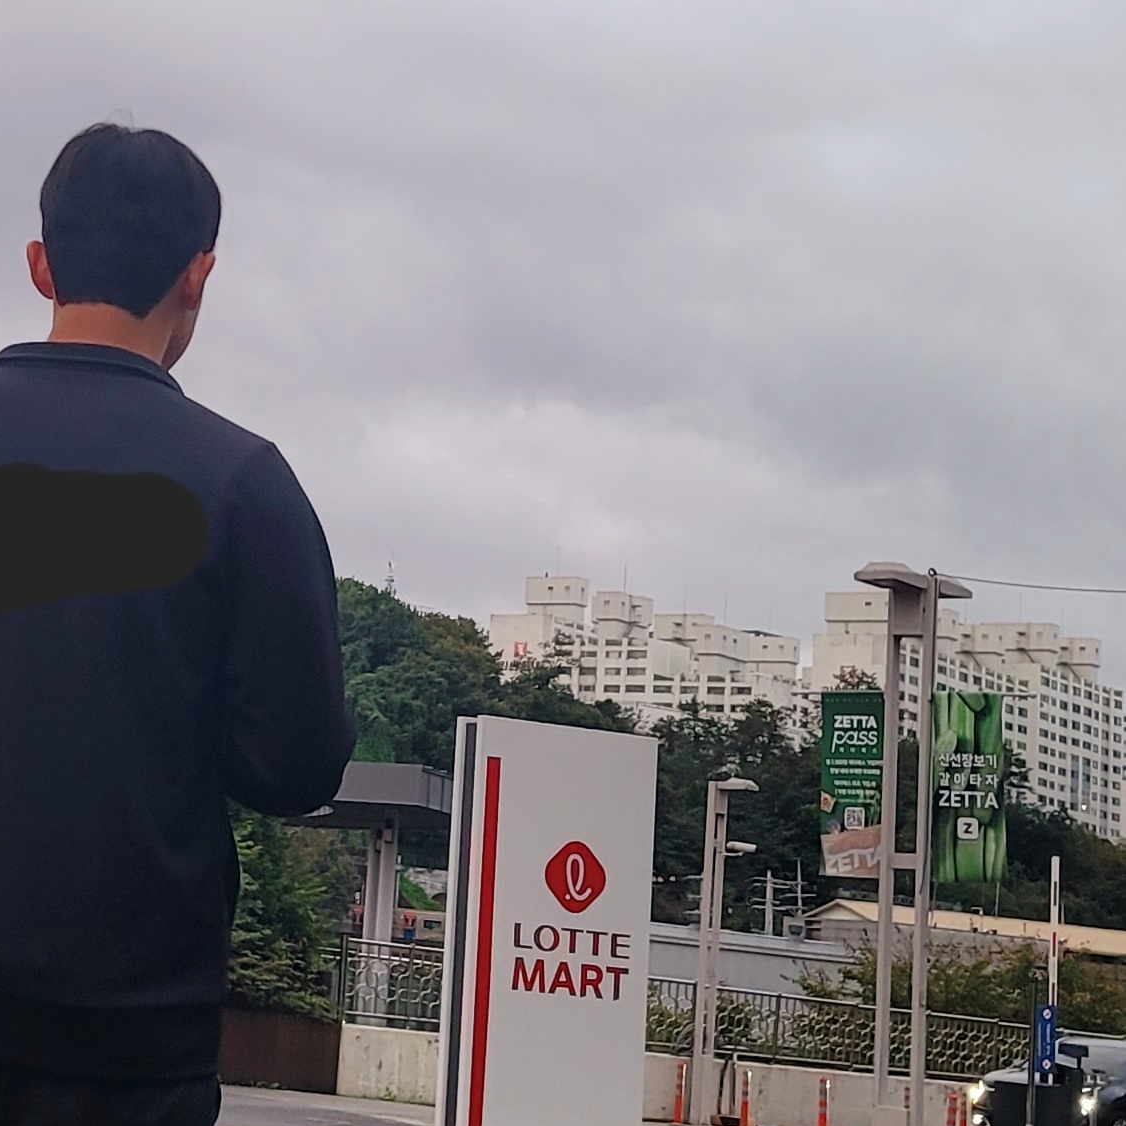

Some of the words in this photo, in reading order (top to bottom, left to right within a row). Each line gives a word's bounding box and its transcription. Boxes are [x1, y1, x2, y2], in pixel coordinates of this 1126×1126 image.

[834, 715, 878, 729] ZETTA
[831, 730, 878, 754] pass
[939, 753, 997, 769] 신선장보기
[938, 789, 1000, 810] ZETTA
[962, 822, 973, 835] Z
[513, 922, 631, 960] LOTTE
[511, 956, 630, 1002] MART
